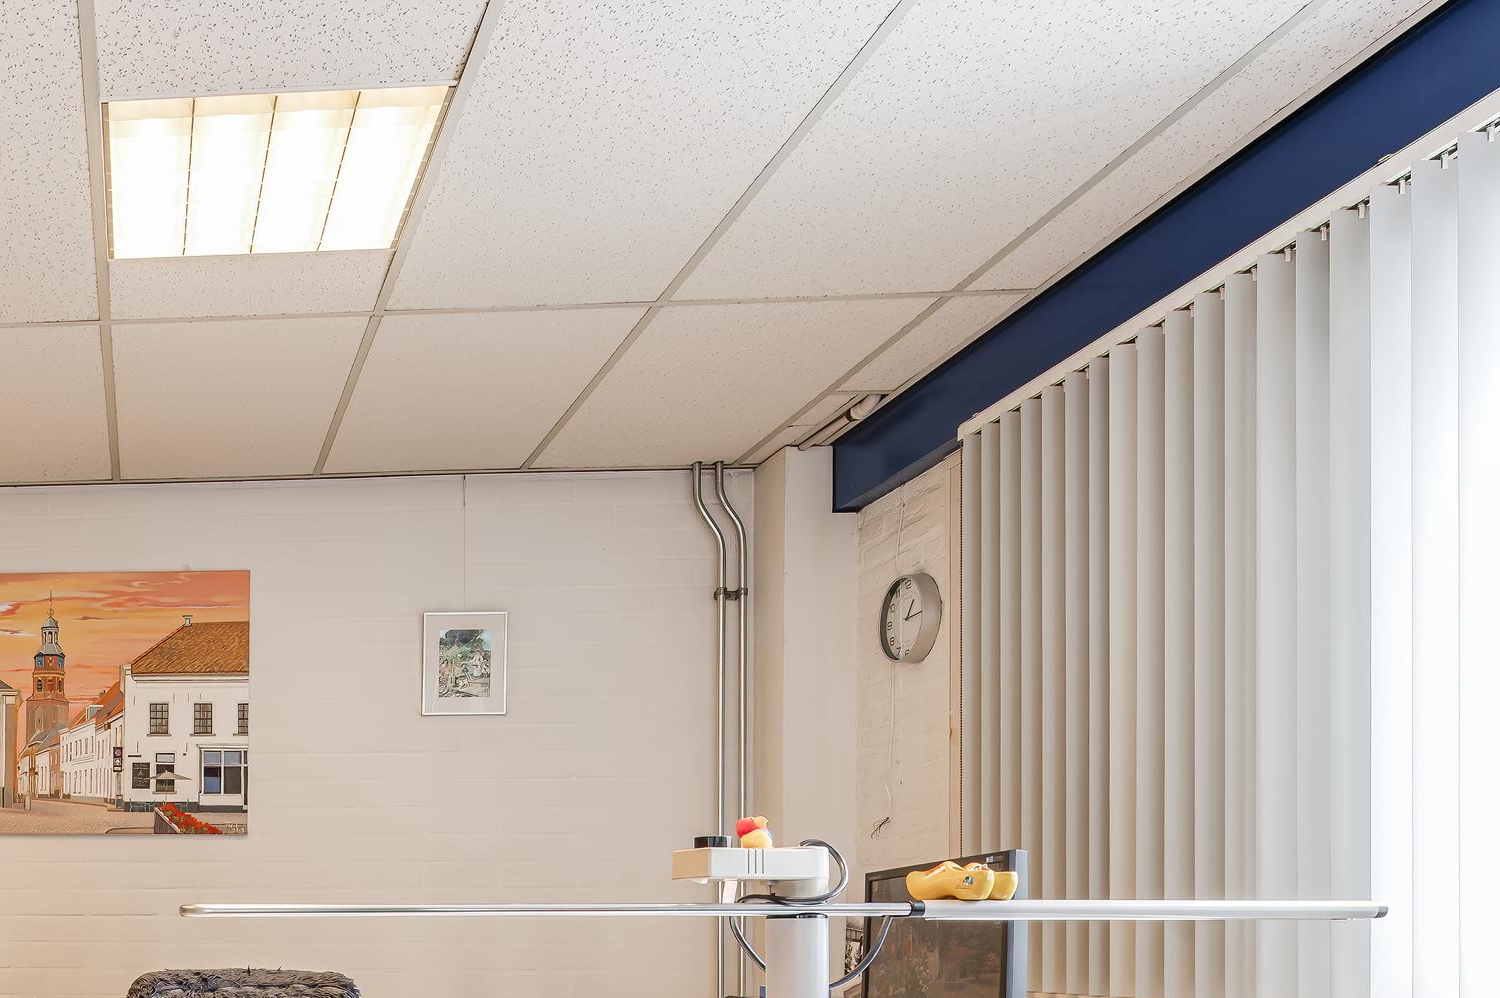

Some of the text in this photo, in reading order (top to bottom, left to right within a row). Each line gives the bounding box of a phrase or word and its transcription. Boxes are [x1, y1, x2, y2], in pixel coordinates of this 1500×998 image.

[887, 621, 893, 630] 9
[889, 637, 895, 646] 8
[896, 647, 901, 656] 7
